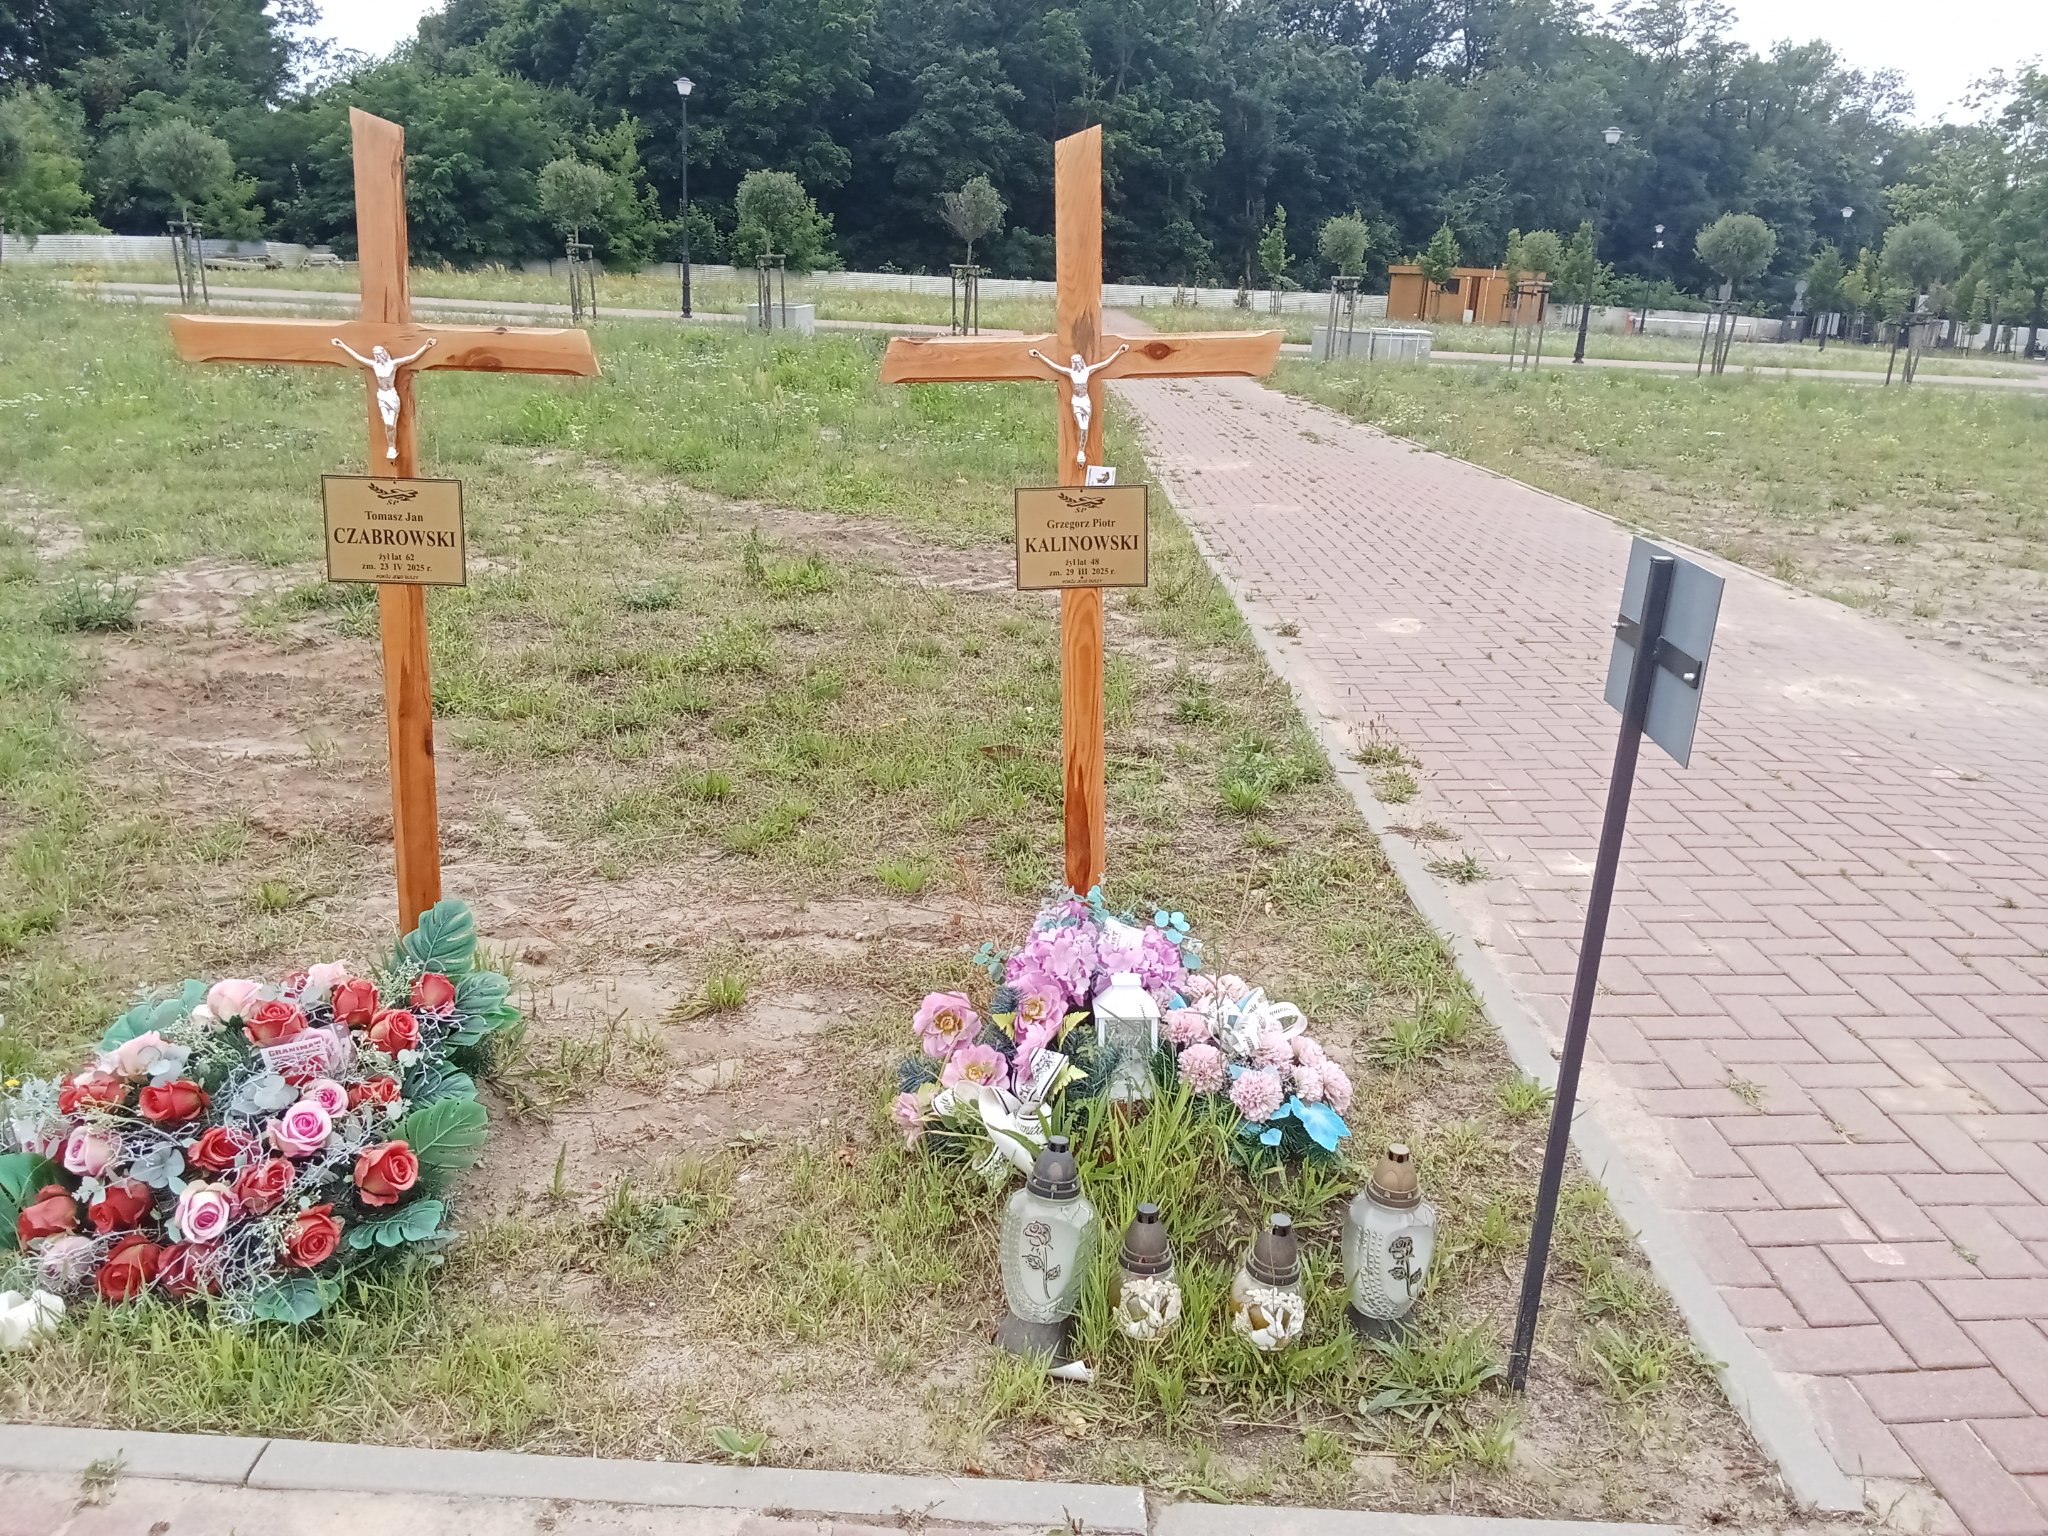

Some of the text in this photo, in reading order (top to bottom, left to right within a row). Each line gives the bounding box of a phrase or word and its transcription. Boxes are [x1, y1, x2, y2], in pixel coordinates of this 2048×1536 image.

[364, 510, 424, 522] Tomasz Jan
[1046, 518, 1116, 531] Grzegorz Piotr
[333, 527, 457, 548] CZABROWSKI
[1025, 534, 1139, 554] KALINOWSKI
[391, 553, 402, 561] lat
[405, 553, 415, 561] 62
[1077, 558, 1087, 566] lat
[1090, 558, 1100, 566] 48
[362, 563, 376, 571] zm.
[380, 563, 389, 571] 23
[393, 563, 403, 571] IV
[407, 564, 425, 572] 2025
[1066, 568, 1075, 576] 29
[1078, 568, 1088, 576] III
[1092, 567, 1109, 575] 2025
